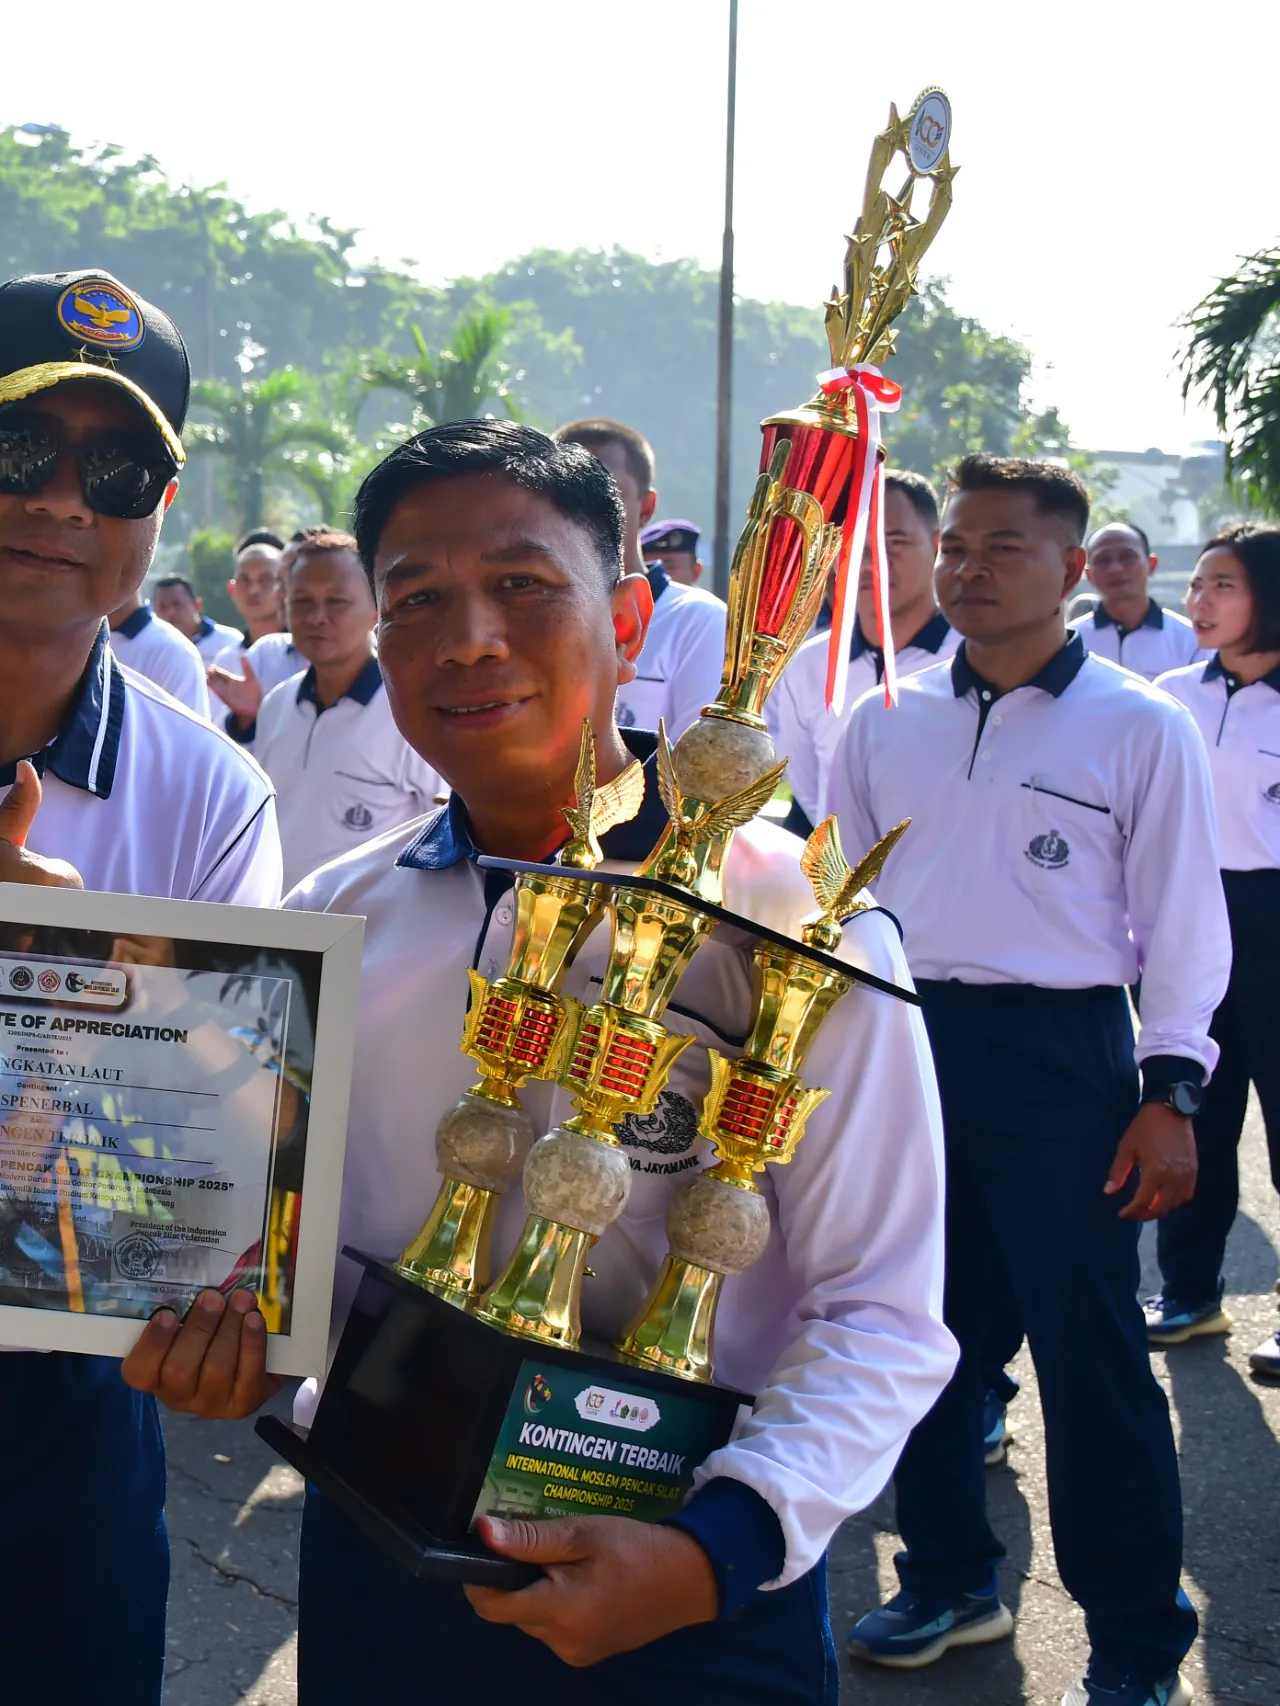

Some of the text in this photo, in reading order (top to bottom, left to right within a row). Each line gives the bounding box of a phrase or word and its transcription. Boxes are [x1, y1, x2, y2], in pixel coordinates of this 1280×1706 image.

[20, 1014, 47, 1030] OF
[50, 1017, 189, 1044] APPRECIATION
[16, 1045, 55, 1055] Presented
[81, 1065, 123, 1081] LAUT
[49, 1130, 119, 1149] TERBAIK
[0, 1159, 52, 1173] PENCAK
[96, 1169, 195, 1187] CHAMPIONSHIP
[0, 1172, 26, 1181] Modern
[72, 1179, 96, 1188] Gontor
[136, 1186, 172, 1196] Indonesia
[33, 1185, 57, 1195] Indoor
[130, 1220, 164, 1230] President
[187, 1226, 227, 1237] Indonesian
[136, 1229, 162, 1238] Pencak
[180, 1233, 220, 1244] Federation
[519, 1421, 686, 1476] KONTINGEN TERBAIK
[506, 1454, 680, 1500] INTERNATIONAL MOSLEM PENCAK SILAT
[543, 1483, 635, 1512] CHAMPIONSHIP 2025
